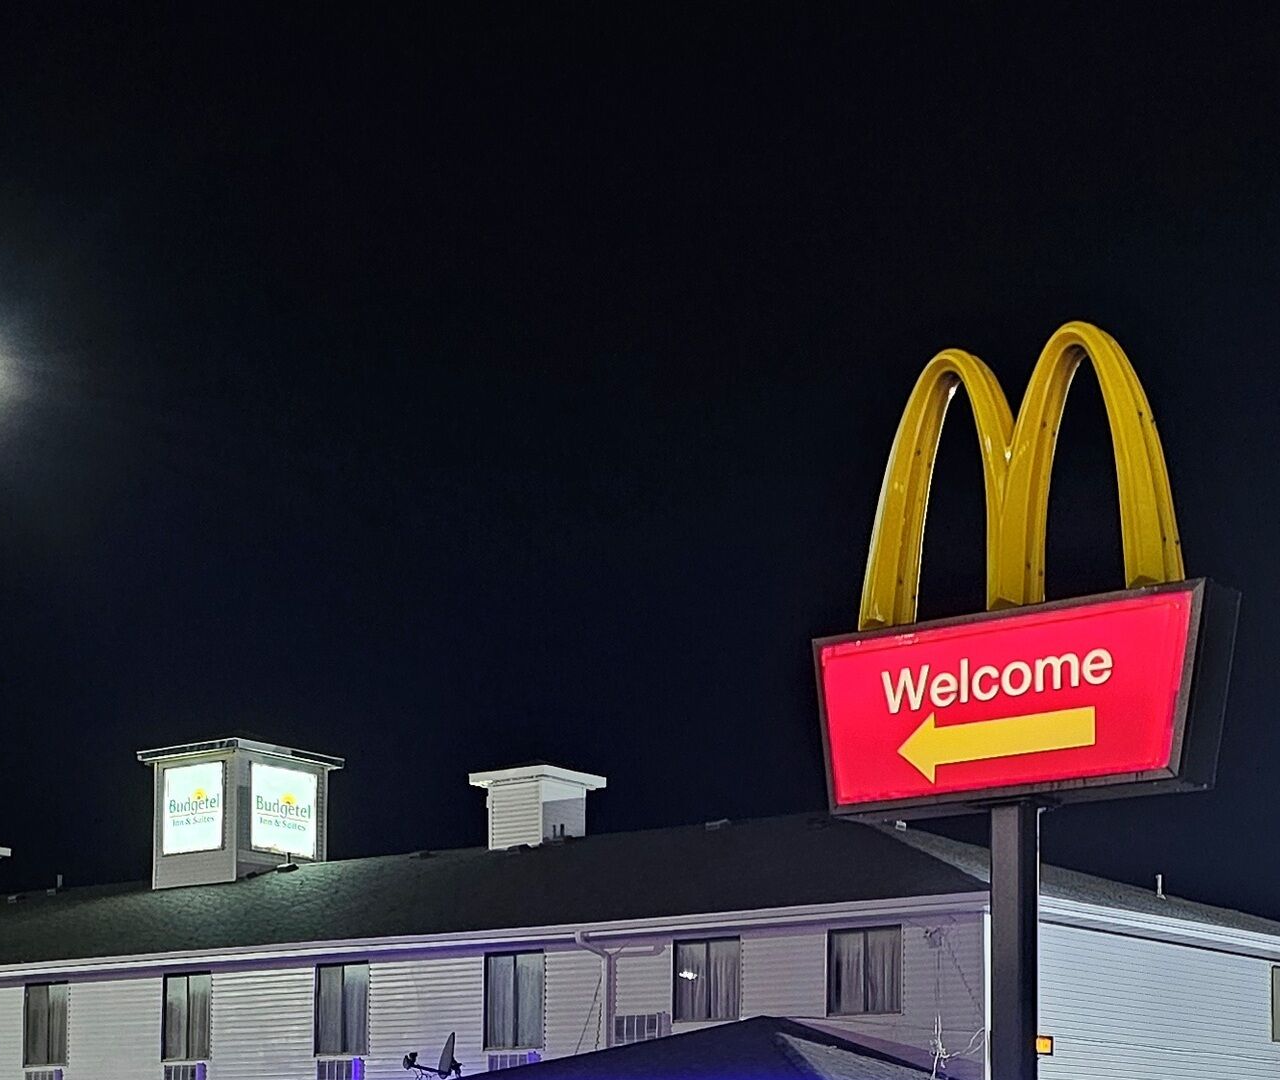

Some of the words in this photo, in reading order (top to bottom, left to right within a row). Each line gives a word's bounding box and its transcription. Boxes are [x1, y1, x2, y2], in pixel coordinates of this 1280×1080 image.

[881, 648, 1113, 714] Welcome
[169, 793, 219, 814] Budgetel
[256, 795, 311, 818] Budgetel
